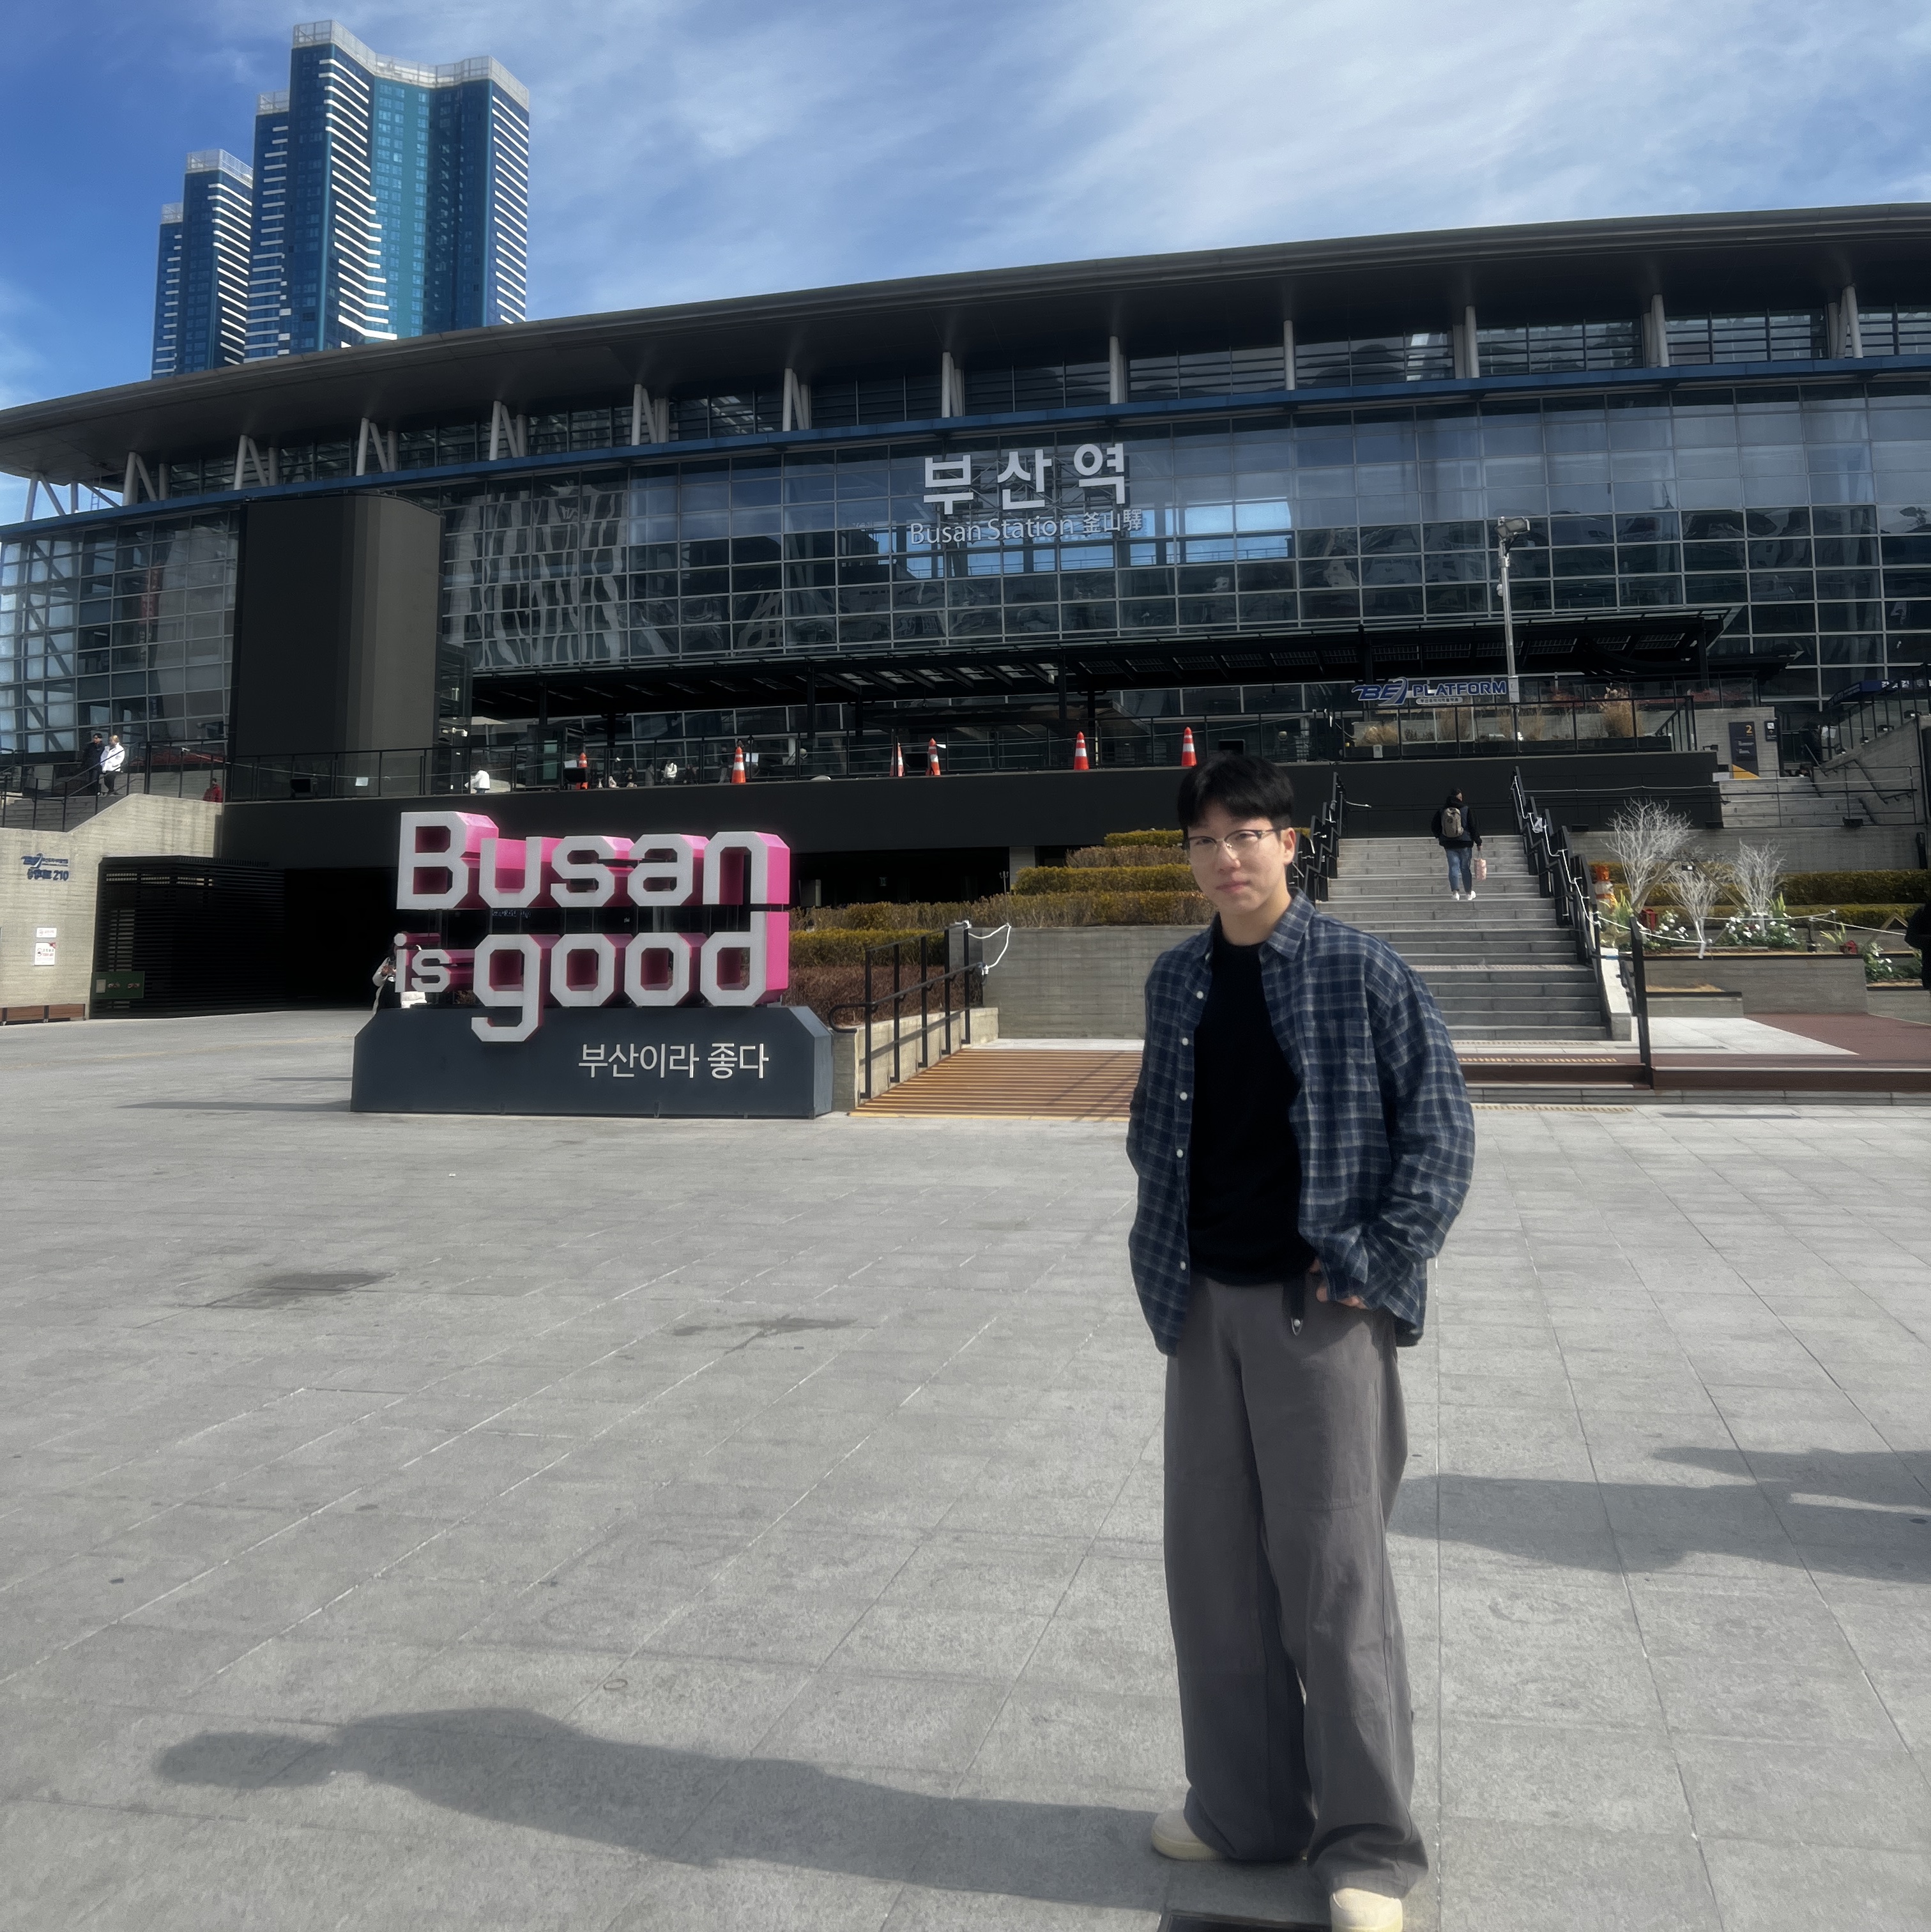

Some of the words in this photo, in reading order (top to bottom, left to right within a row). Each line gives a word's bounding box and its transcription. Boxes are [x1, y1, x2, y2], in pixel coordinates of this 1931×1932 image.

[923, 443, 1126, 515] 부산역
[910, 518, 982, 545] Busan
[988, 515, 1074, 540] Station
[1082, 509, 1142, 533] 釜山驛
[1412, 681, 1507, 697] PLATFORM
[1746, 725, 1753, 733] 2
[53, 870, 69, 881] 210
[397, 811, 767, 910] Busan
[394, 933, 452, 993] is
[471, 911, 767, 1043] good
[579, 1043, 699, 1080] 부산이라
[707, 1042, 769, 1080] 좋다
